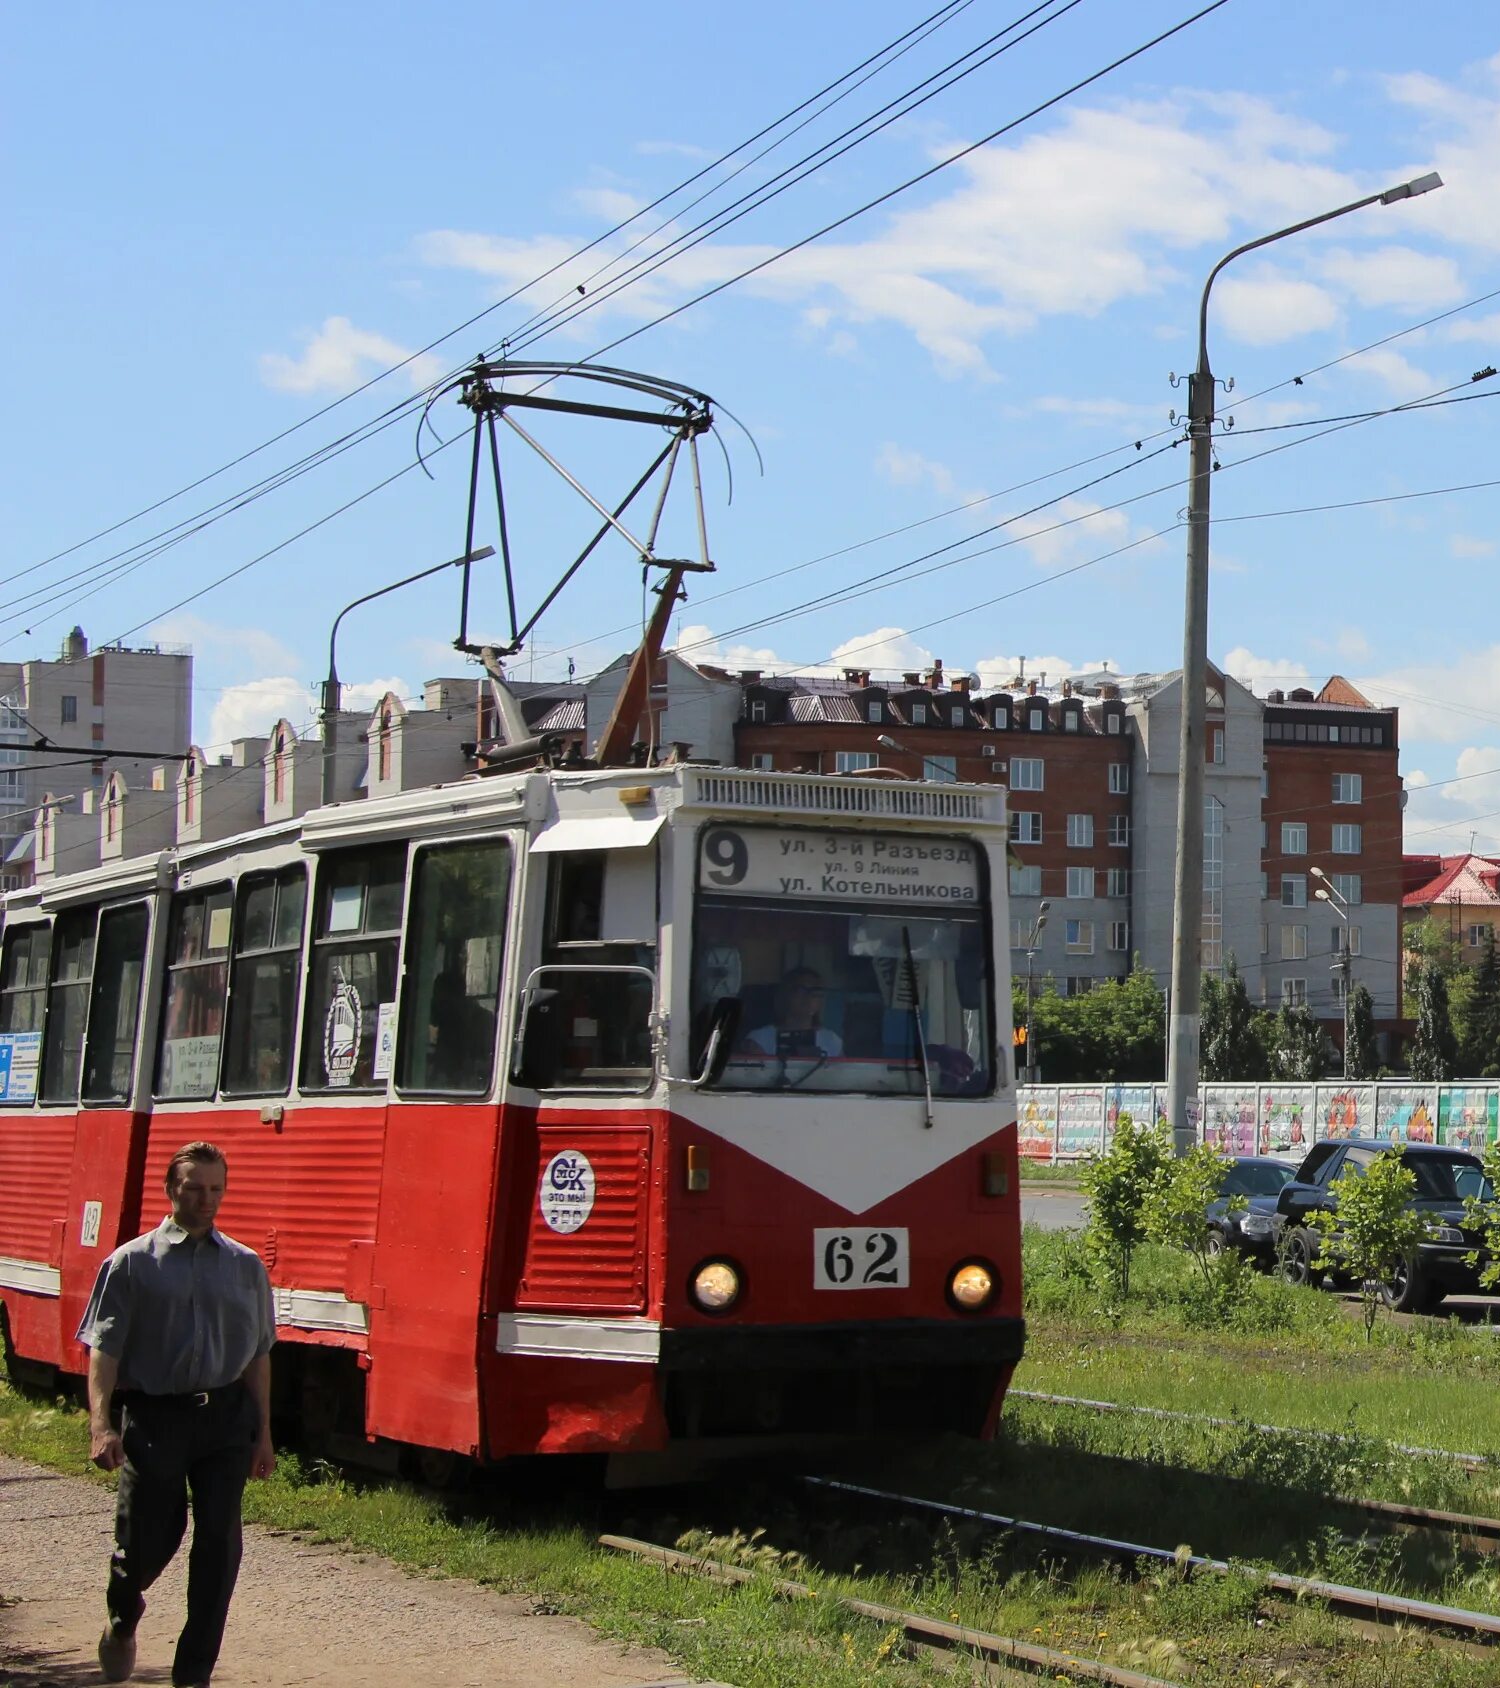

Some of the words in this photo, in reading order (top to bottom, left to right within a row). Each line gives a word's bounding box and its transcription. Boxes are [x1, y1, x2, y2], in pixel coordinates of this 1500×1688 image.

[705, 830, 749, 886] 9
[780, 838, 814, 856] ул.
[825, 837, 863, 856] 3-й
[873, 840, 972, 864] Разъезд
[824, 862, 848, 875] ул.
[854, 861, 864, 874] 9
[869, 862, 920, 876] Линия
[779, 877, 812, 894] ул.
[821, 875, 975, 900] Котельникова
[549, 1192, 565, 1203] ЭТО
[84, 1207, 98, 1241] 62
[824, 1232, 898, 1284] 62
